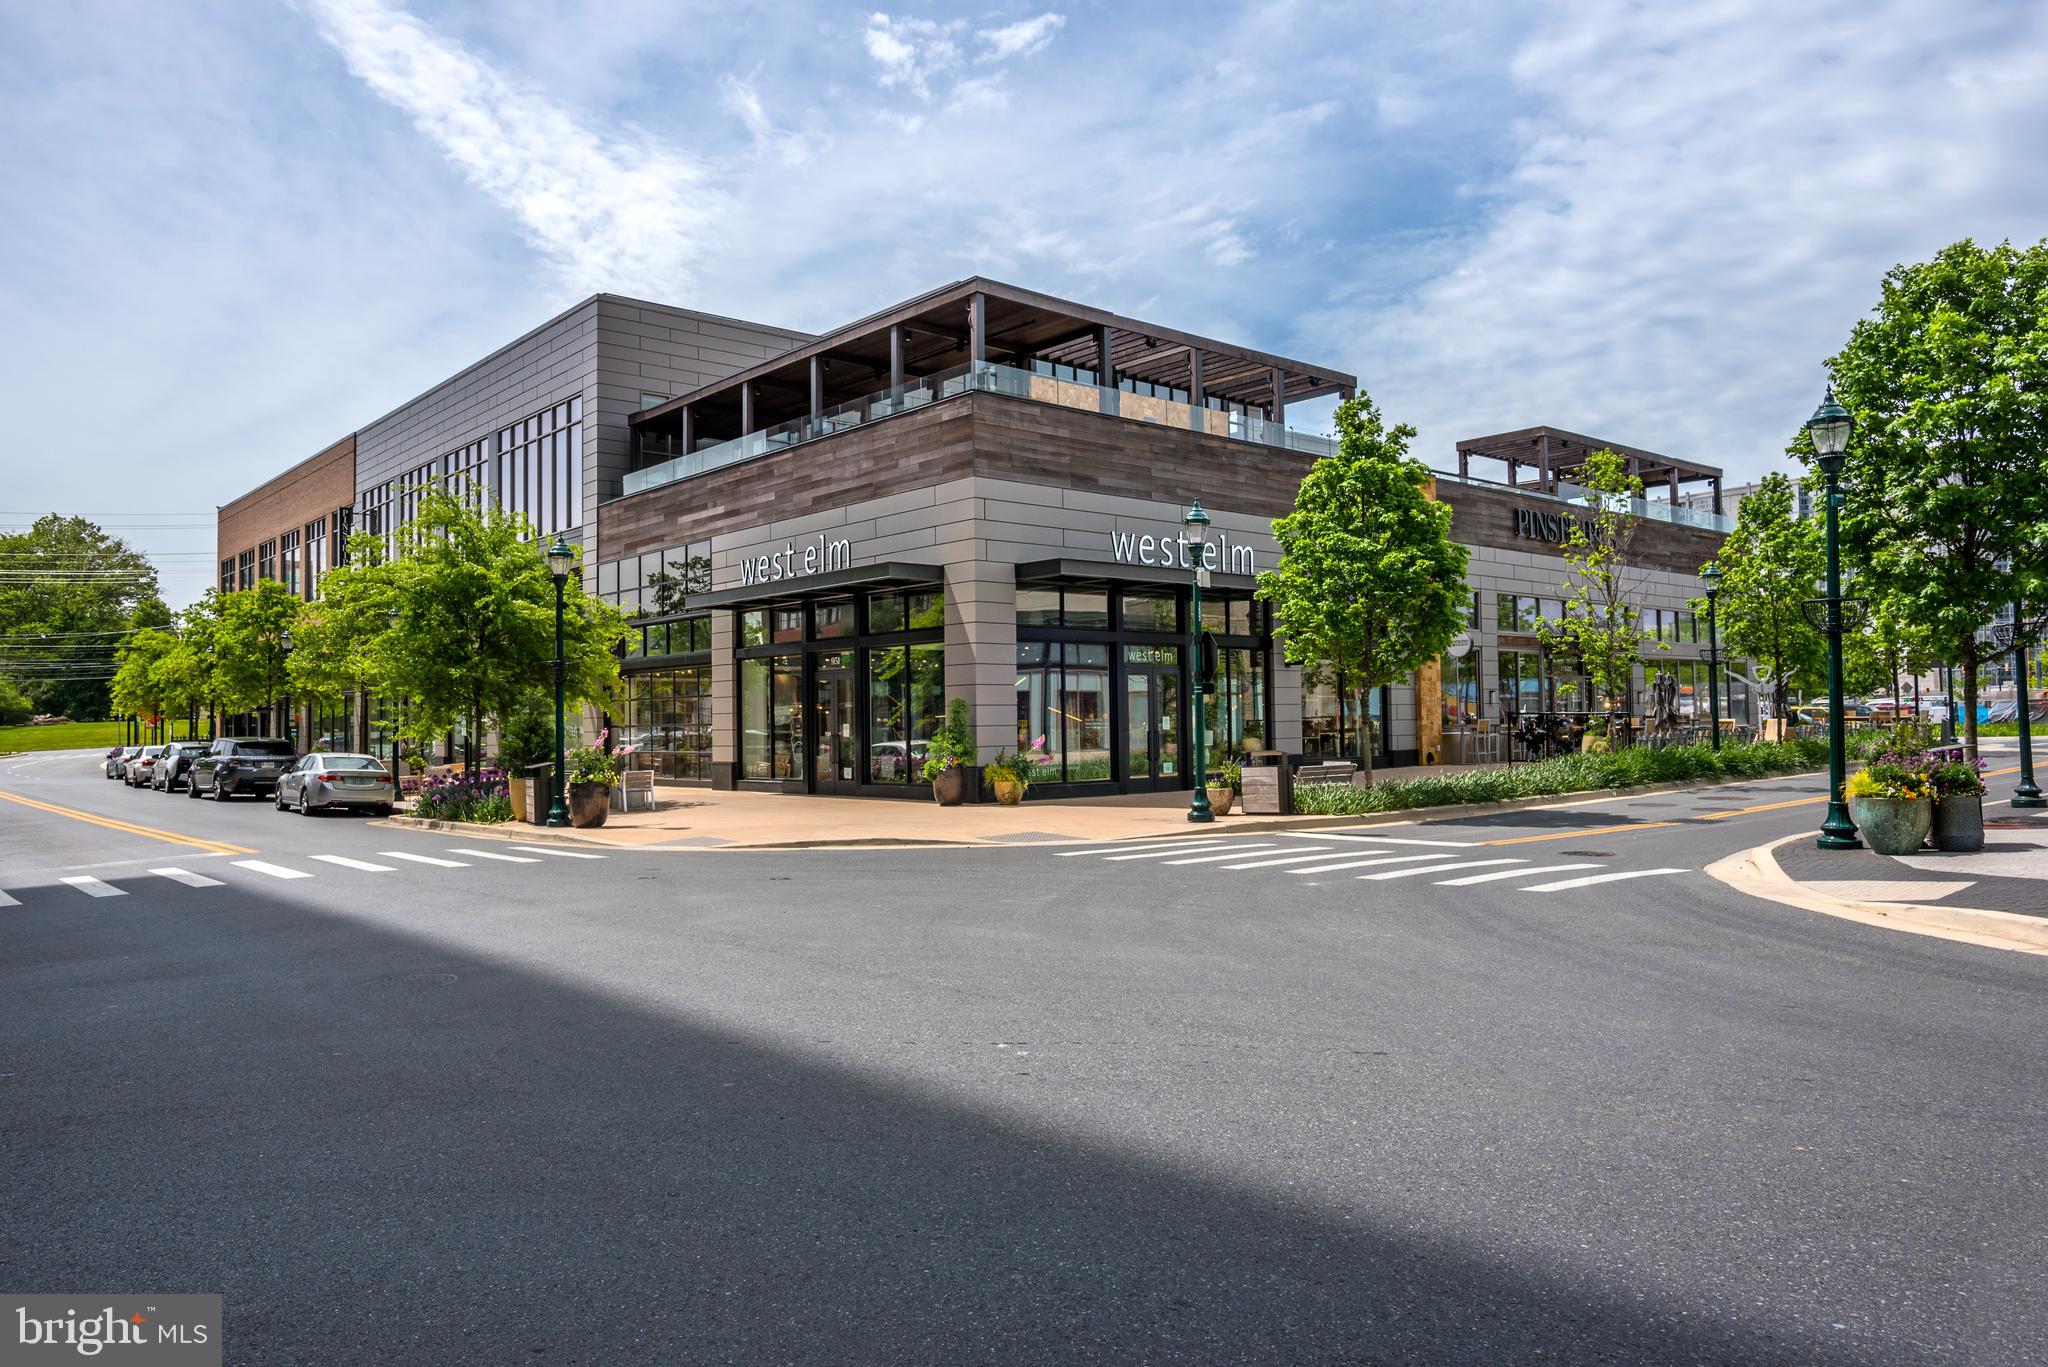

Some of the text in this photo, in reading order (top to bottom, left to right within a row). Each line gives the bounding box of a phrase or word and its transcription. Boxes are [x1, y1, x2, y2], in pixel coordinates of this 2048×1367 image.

[740, 534, 852, 586] west elm
[1110, 530, 1254, 574] west elm
[1128, 648, 1174, 663] west elm
[1042, 766, 1057, 777] elm
